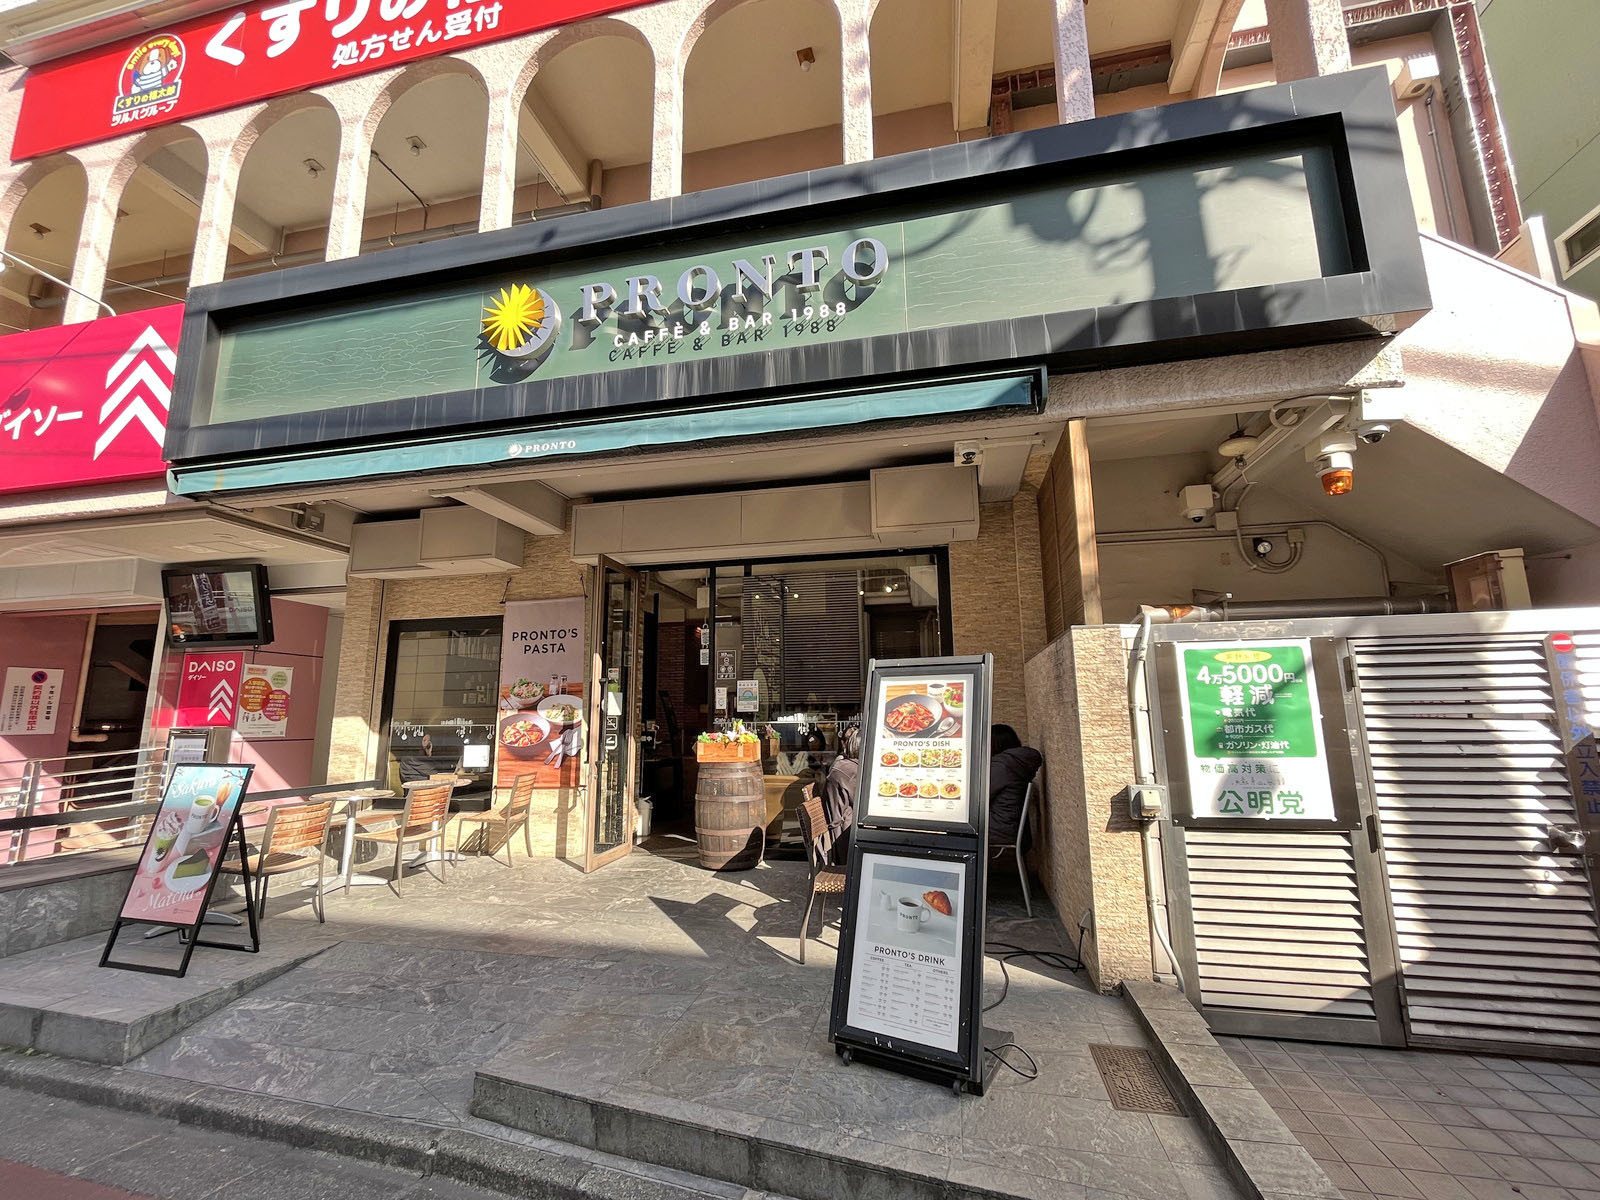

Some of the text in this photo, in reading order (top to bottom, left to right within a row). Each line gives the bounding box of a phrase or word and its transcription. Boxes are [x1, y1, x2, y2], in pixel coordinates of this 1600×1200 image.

[331, 1, 502, 69] 処方せん受付
[578, 237, 890, 326] PRONTO
[613, 302, 846, 347] CAFFÈ & BAR 1988
[525, 440, 577, 453] PRONTO
[512, 628, 578, 642] PRONTO'S
[524, 643, 566, 654] PASTA
[189, 660, 236, 673] DAISO
[1219, 684, 1275, 706] 軽減
[1224, 724, 1275, 735] 都市ガス代
[1226, 740, 1291, 751] ガソリン・灯油代
[1217, 790, 1305, 815] 公明党
[874, 945, 945, 966] PRONTO'S DRINK
